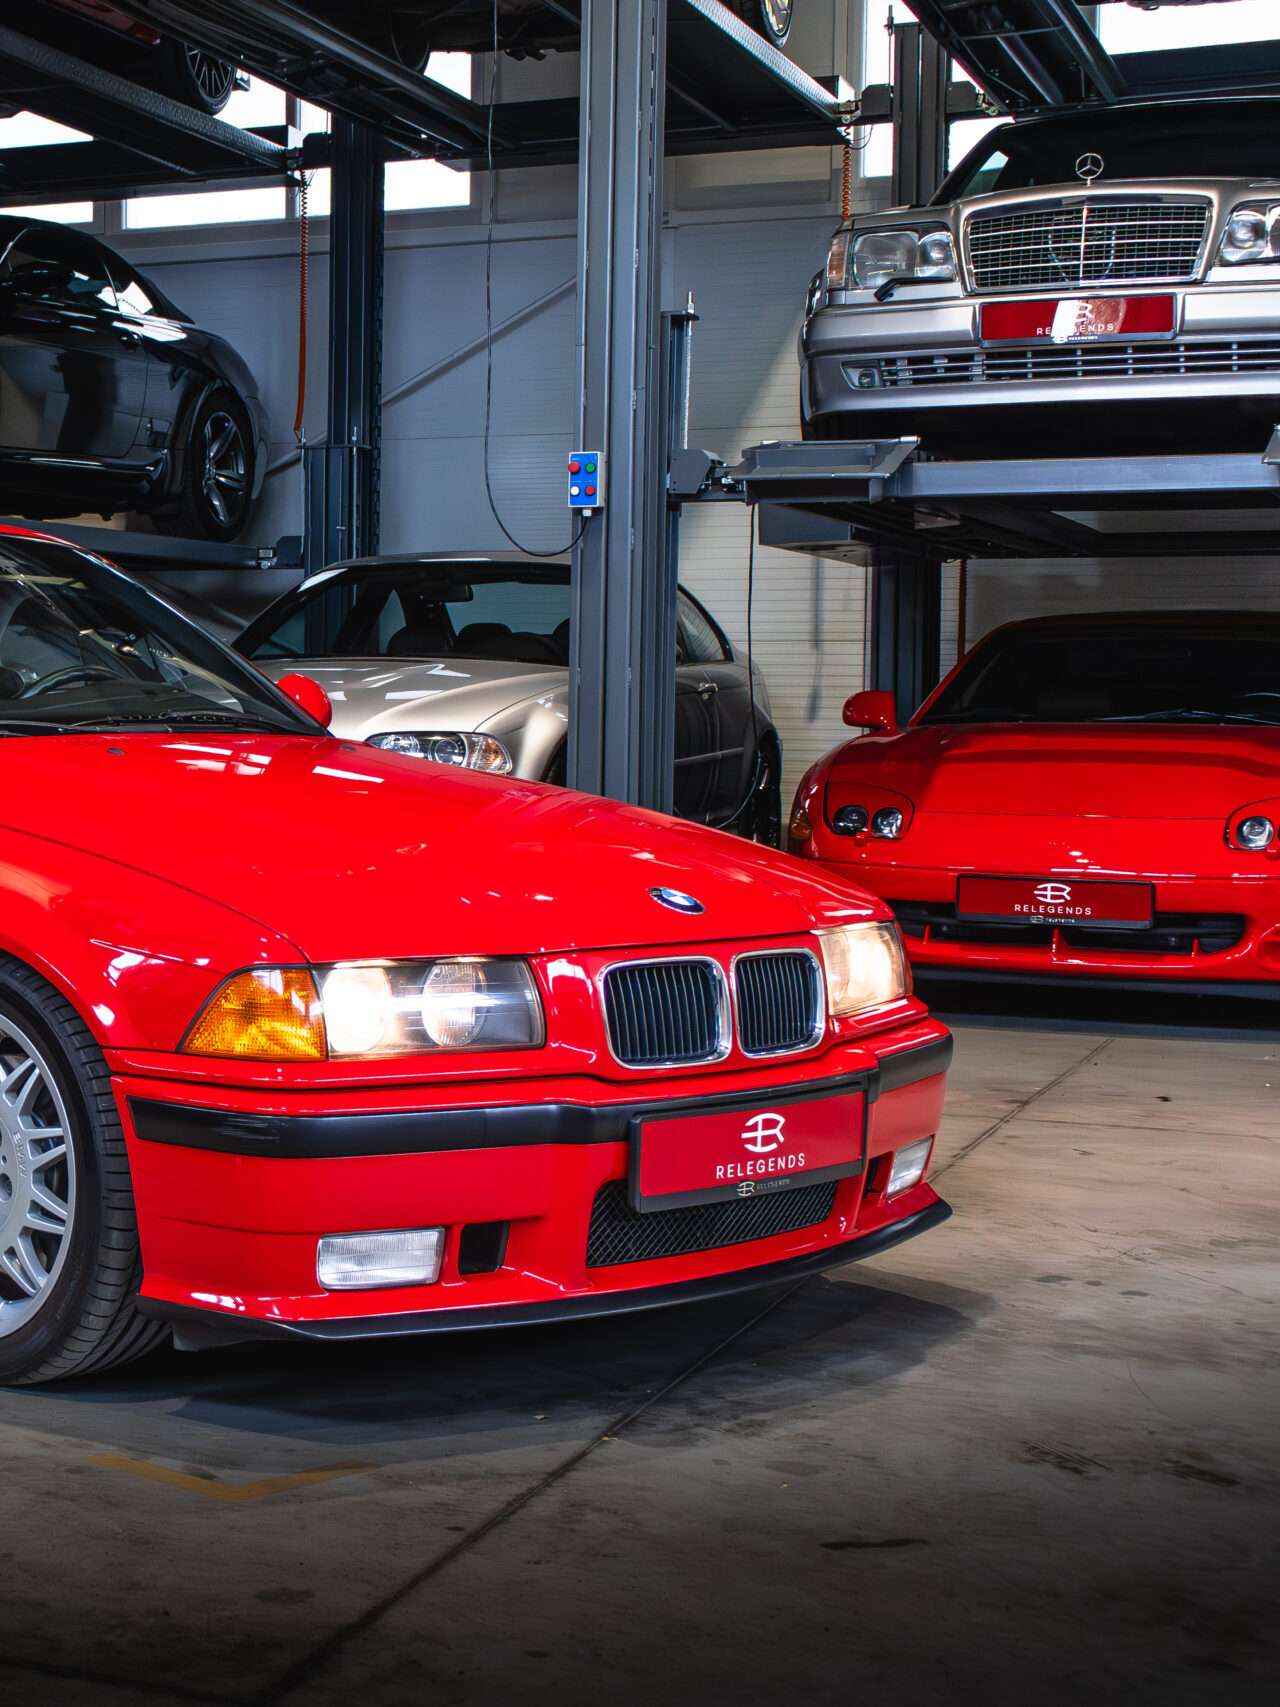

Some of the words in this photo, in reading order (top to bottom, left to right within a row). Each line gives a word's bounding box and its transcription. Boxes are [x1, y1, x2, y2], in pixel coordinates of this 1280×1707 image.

[1036, 323, 1114, 335] REENDS
[1014, 904, 1092, 915] RELEGENDS
[12, 1132, 28, 1178] BMW
[715, 1152, 805, 1179] RELEGENDS
